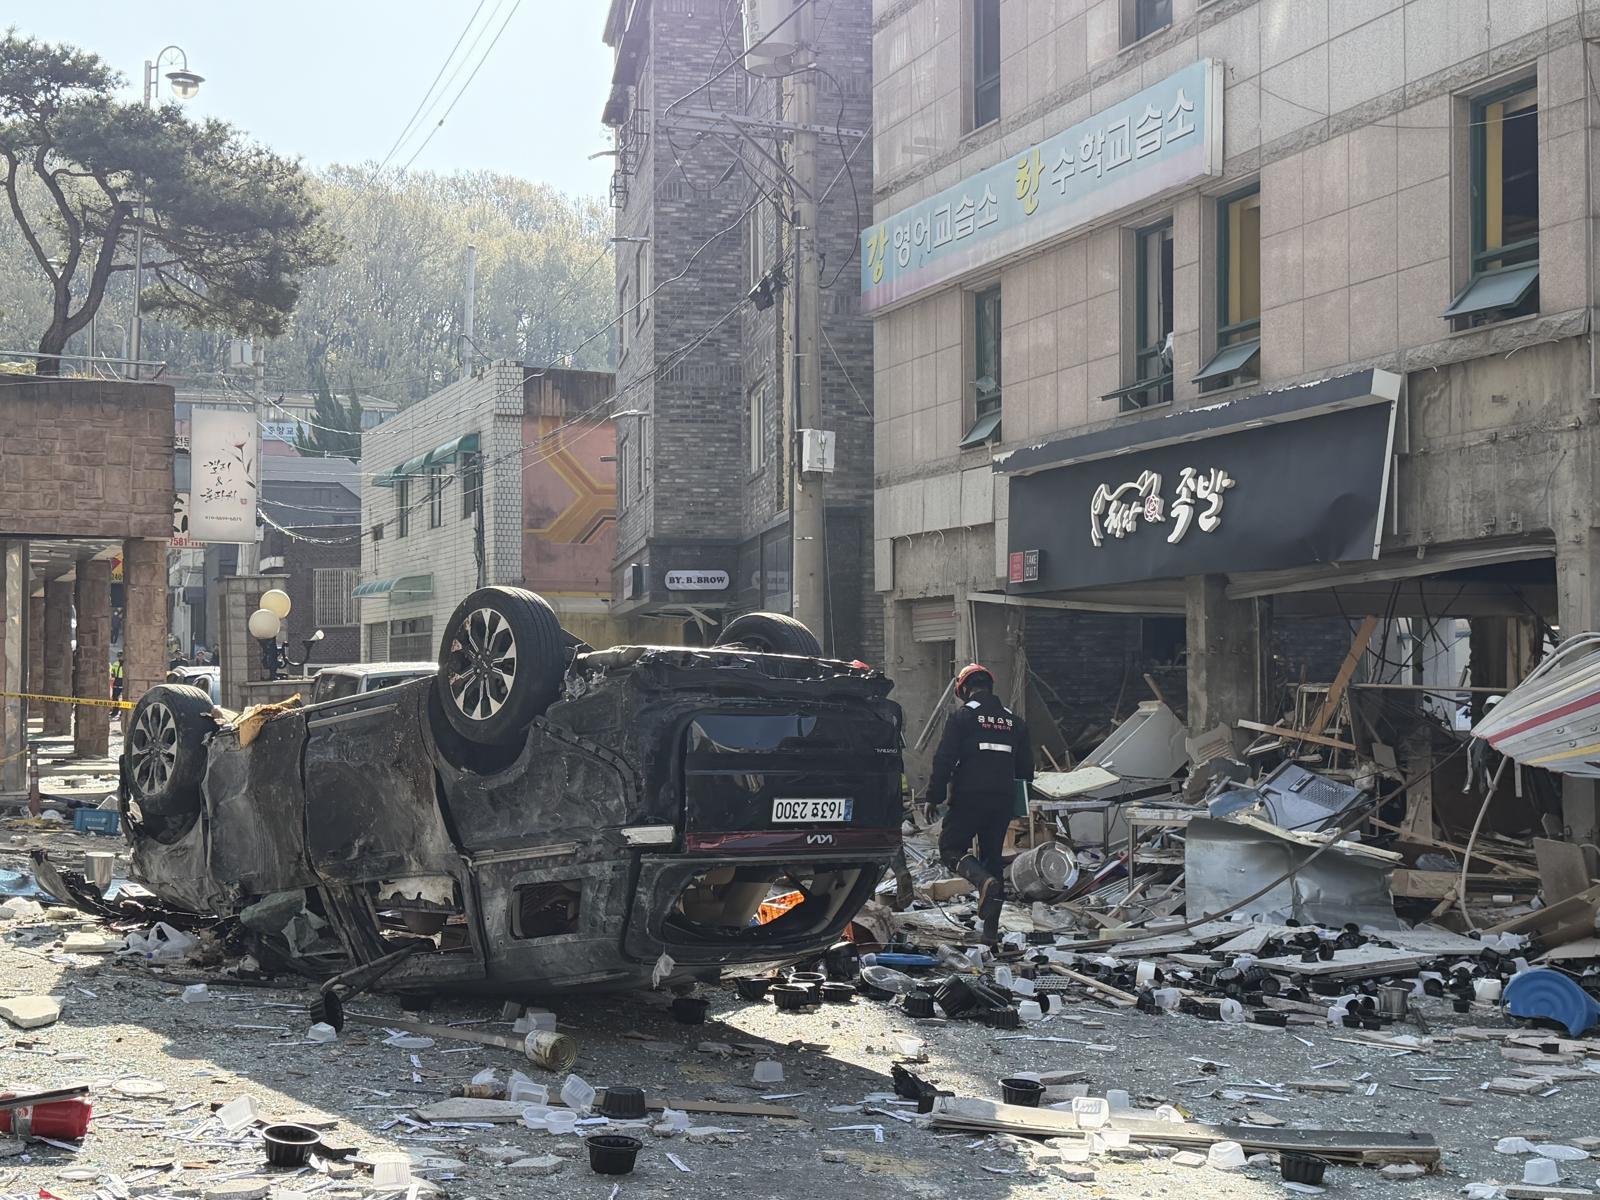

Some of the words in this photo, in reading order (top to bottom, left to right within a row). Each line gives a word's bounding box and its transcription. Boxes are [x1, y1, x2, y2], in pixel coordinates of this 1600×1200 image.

[1167, 466, 1236, 544] 족발
[1026, 555, 1037, 565] TAKE
[1025, 566, 1037, 577] OUT
[775, 801, 809, 819] 2300
[811, 801, 842, 819] 163호
